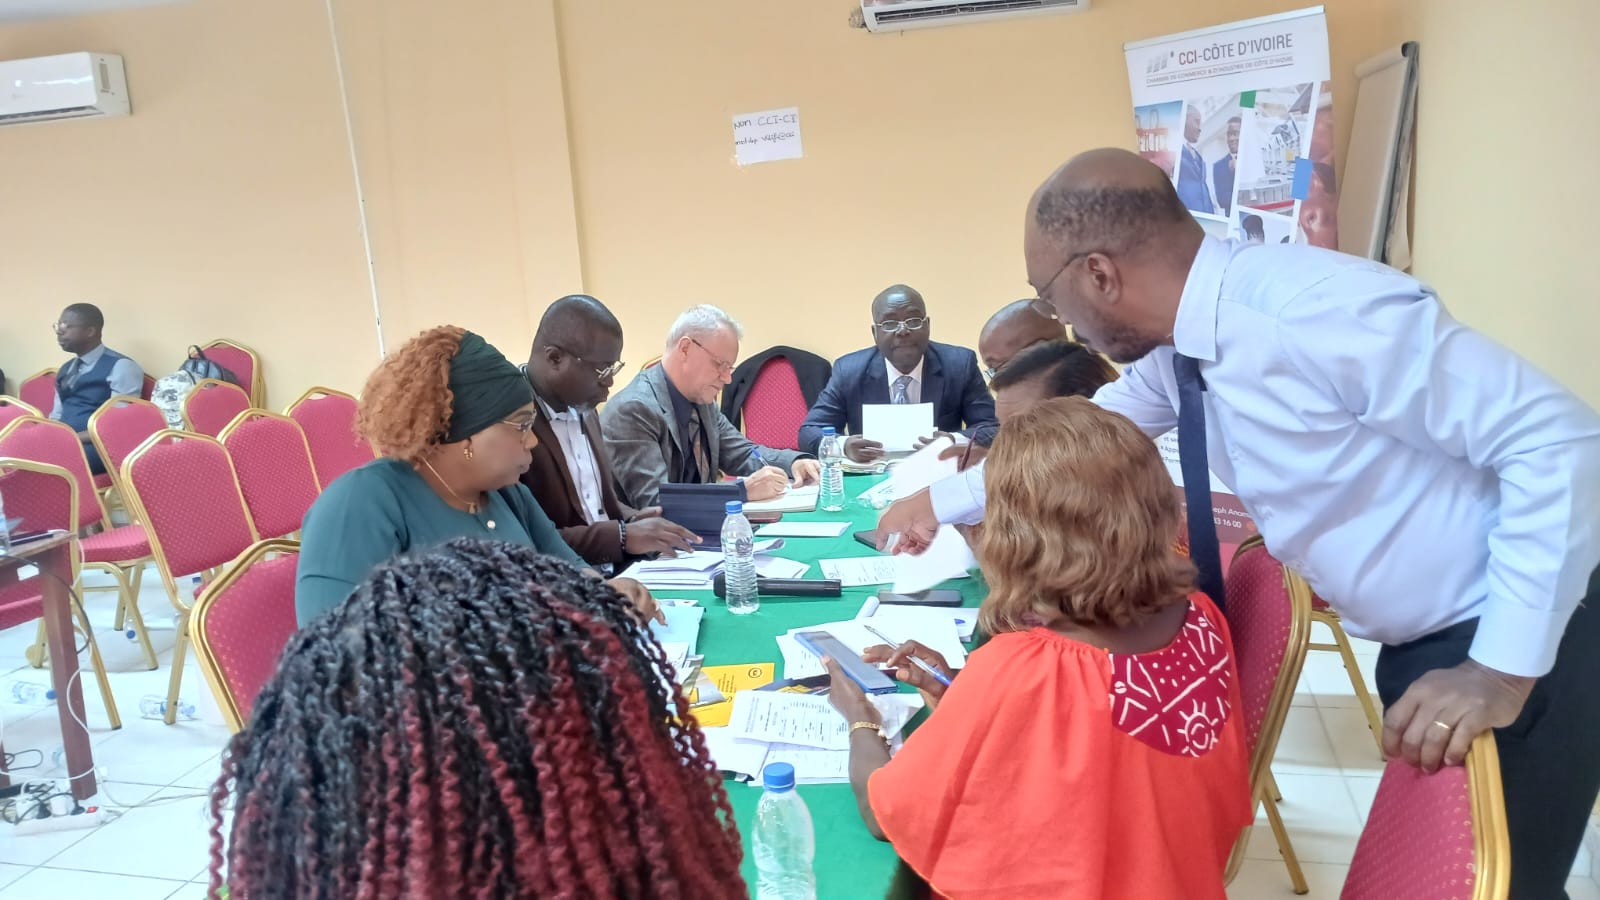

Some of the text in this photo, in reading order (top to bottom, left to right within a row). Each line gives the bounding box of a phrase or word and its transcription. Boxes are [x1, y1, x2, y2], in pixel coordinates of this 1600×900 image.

[1179, 33, 1293, 65] CCI-CÔTE D'IVOIRE
[1232, 520, 1242, 528] 00
